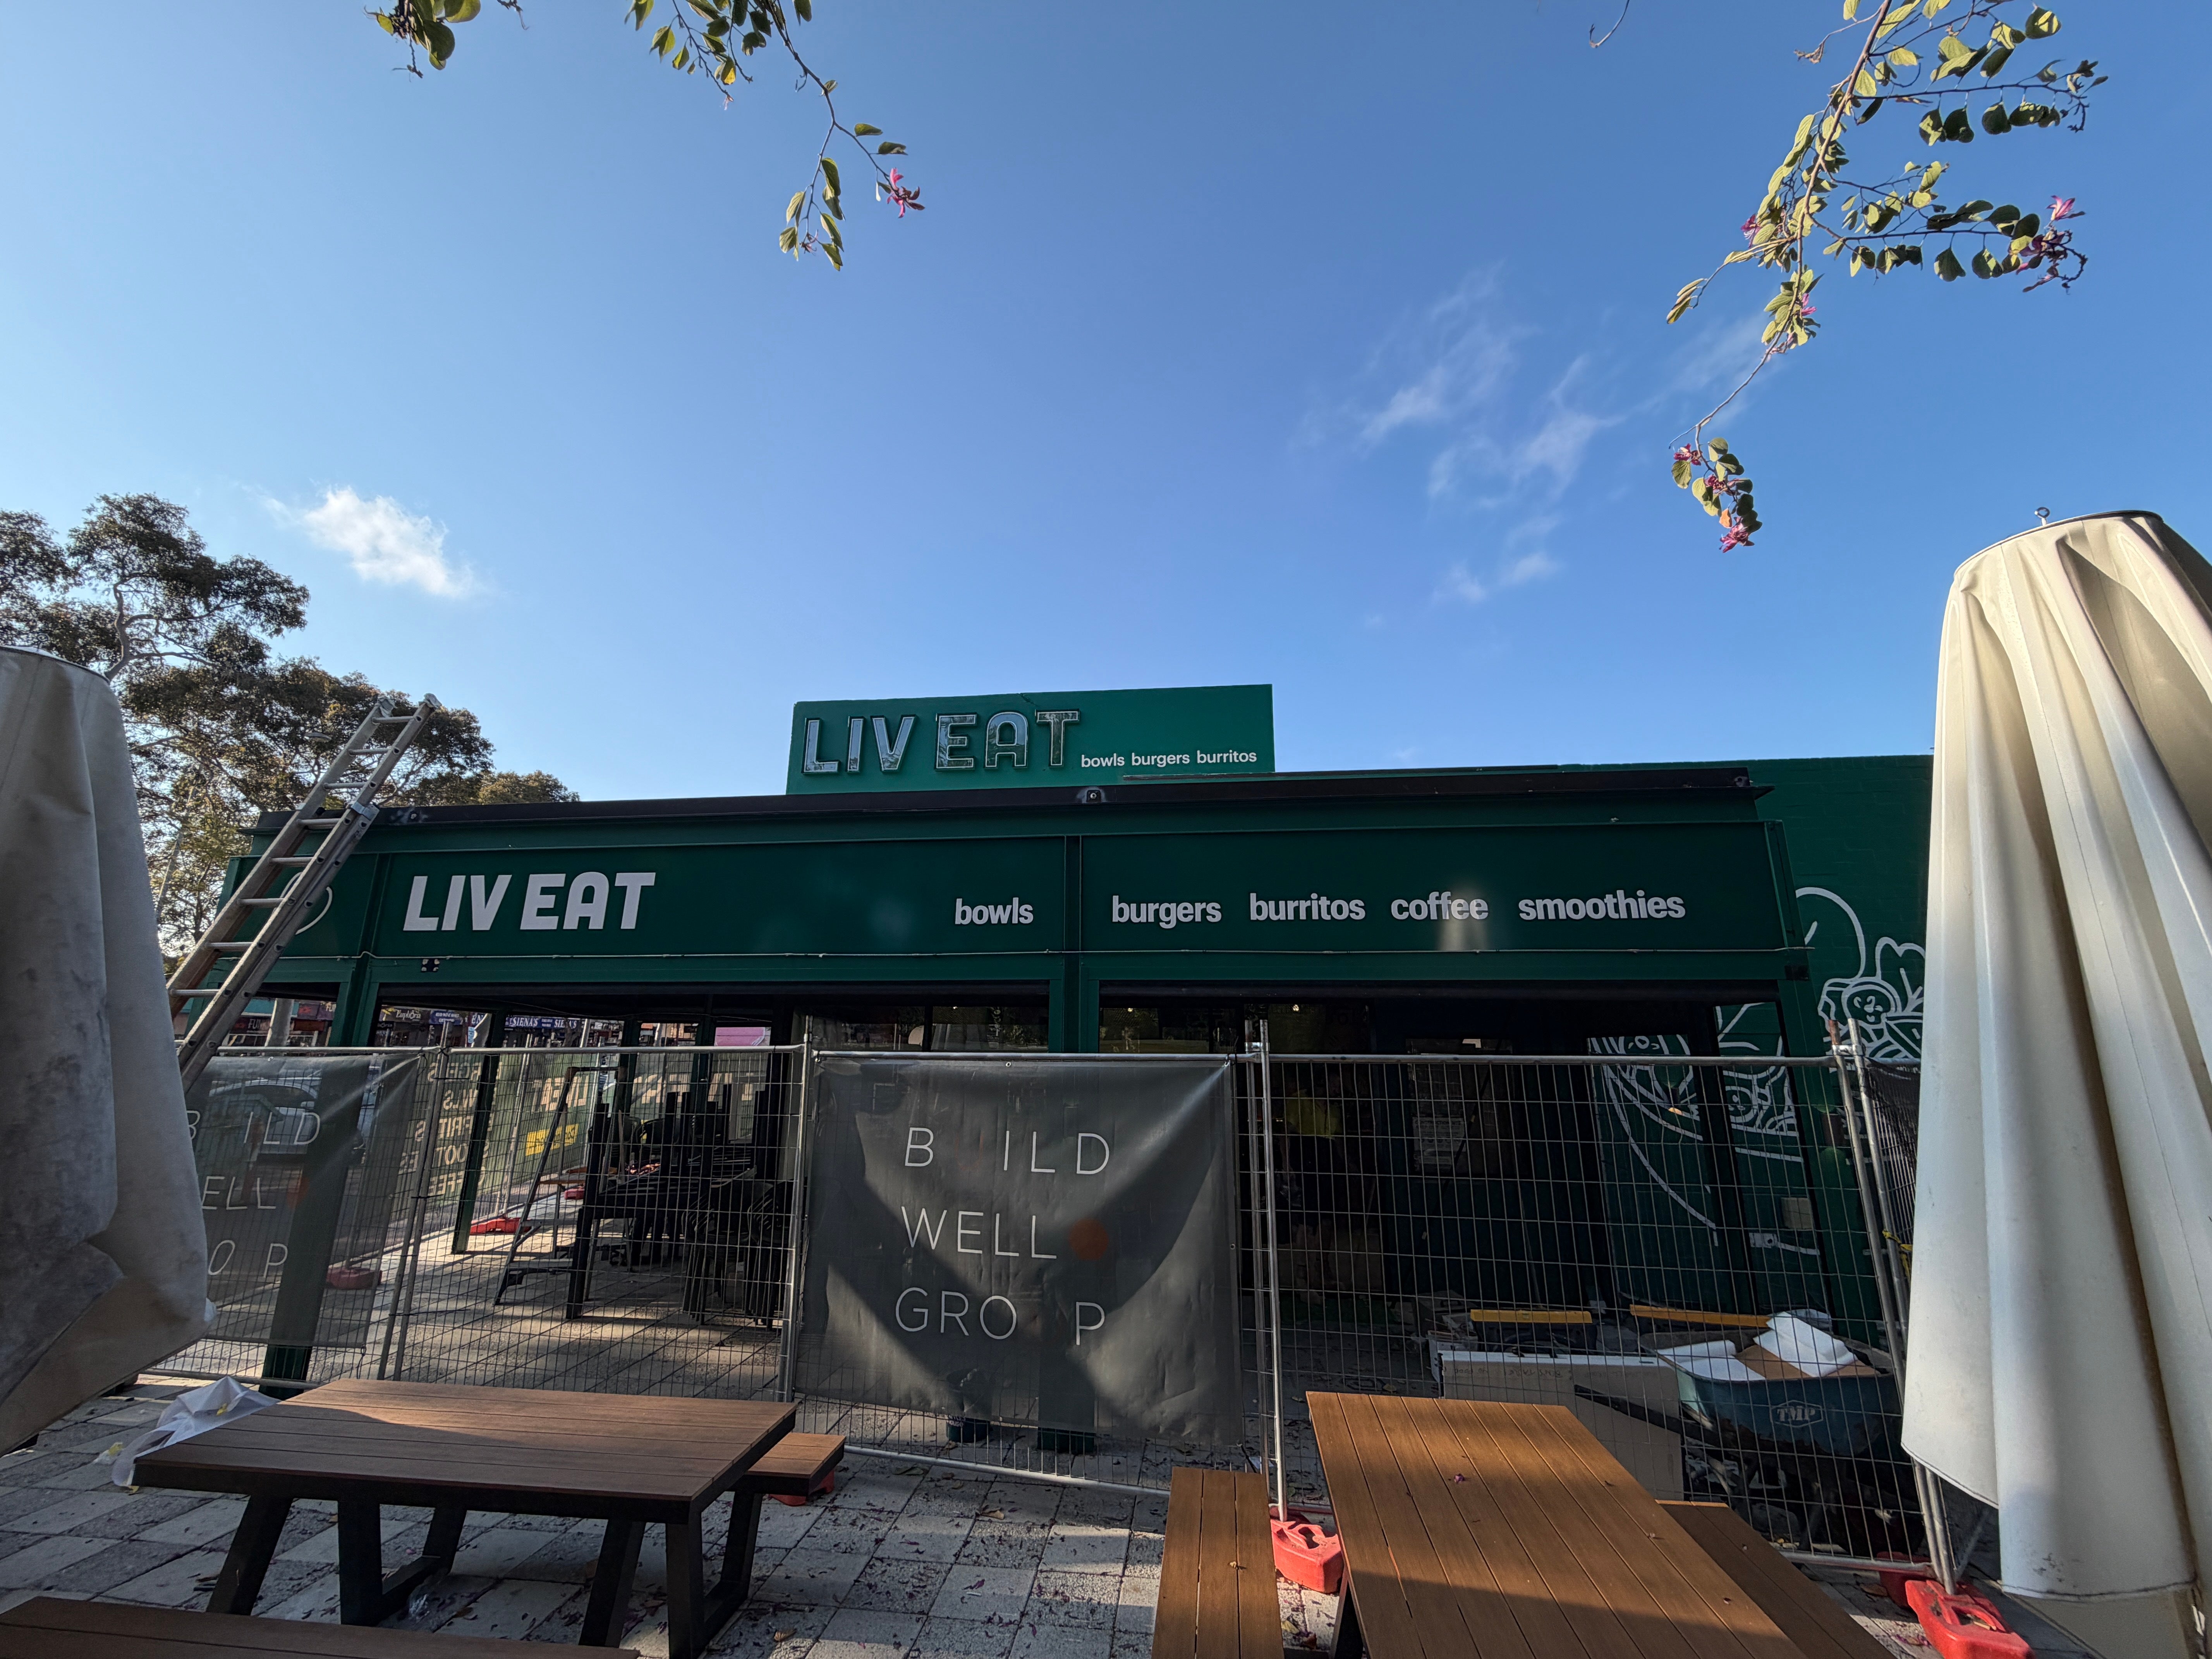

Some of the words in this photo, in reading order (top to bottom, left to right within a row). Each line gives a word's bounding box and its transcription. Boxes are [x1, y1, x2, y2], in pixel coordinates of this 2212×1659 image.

[801, 714, 917, 774] LIV
[935, 709, 1079, 771] EAT
[1081, 753, 1125, 768] bowls
[1131, 752, 1190, 767] burgers
[1197, 750, 1257, 764] burritos
[403, 875, 512, 931] LIV
[520, 871, 656, 930] EAT
[954, 897, 1034, 925] bowls
[1111, 895, 1222, 929] burgers
[1249, 892, 1366, 921] burritos
[1391, 891, 1489, 920] coffee
[1518, 890, 1686, 921] smoothies
[201, 1176, 276, 1210] ELL
[901, 1206, 1057, 1259] WELL
[895, 1287, 1105, 1346] GROP
[1777, 1405, 1815, 1421] TMP
